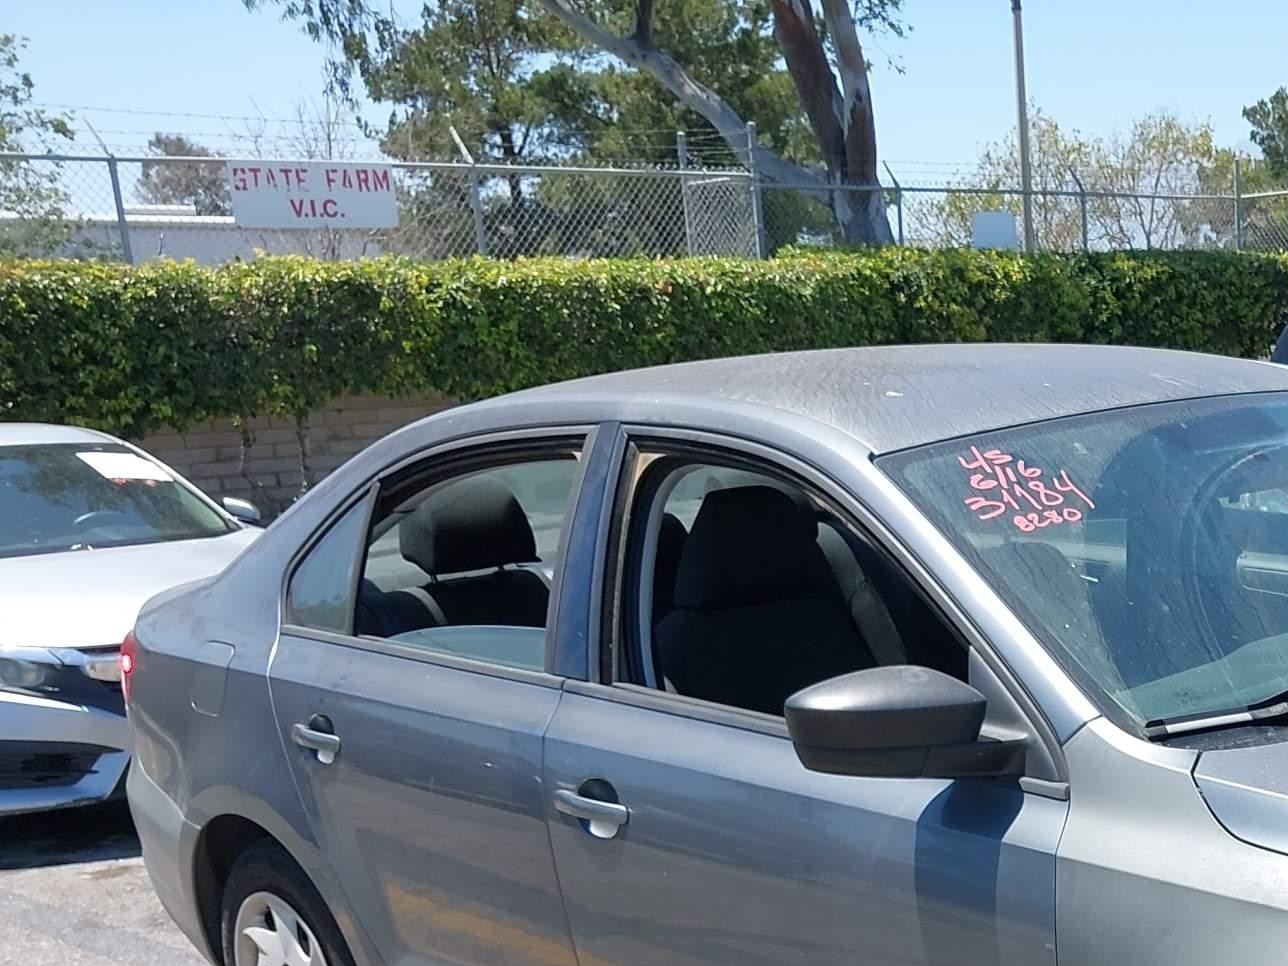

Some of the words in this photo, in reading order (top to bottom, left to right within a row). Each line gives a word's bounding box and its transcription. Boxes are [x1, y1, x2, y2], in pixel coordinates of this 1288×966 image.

[233, 168, 309, 192] STATE
[325, 169, 391, 193] FARM
[290, 199, 346, 218] V.I.C.
